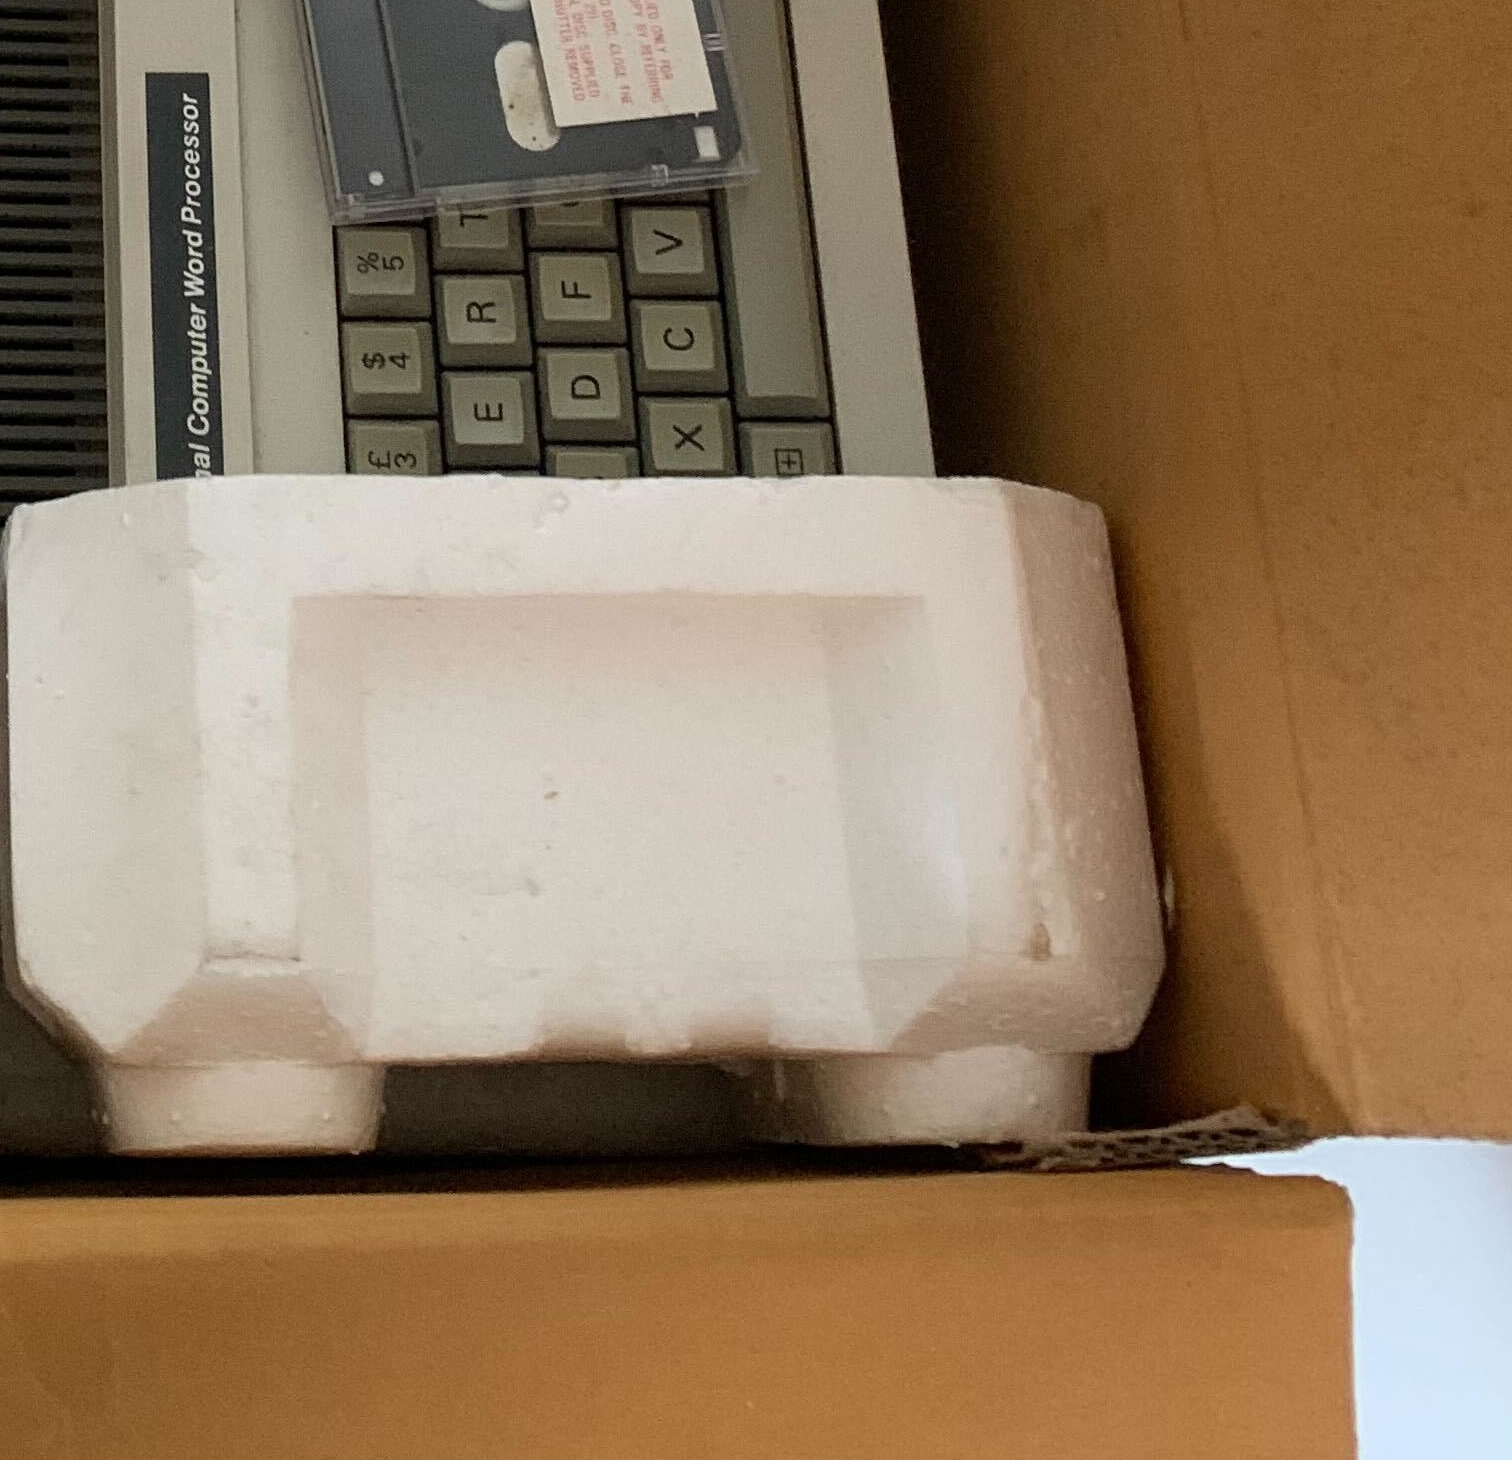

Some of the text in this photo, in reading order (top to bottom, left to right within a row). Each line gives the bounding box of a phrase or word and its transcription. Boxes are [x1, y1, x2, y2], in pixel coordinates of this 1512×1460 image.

[650, 24, 669, 53] ONLY
[578, 44, 600, 98] SUPPLIED
[608, 42, 627, 78] CLOSE
[658, 58, 675, 80] FOR
[563, 47, 586, 101] REMOVED
[617, 85, 633, 105] THE
[181, 93, 202, 224] Processor
[653, 229, 683, 256] V
[183, 229, 205, 298] Word
[382, 255, 405, 271] 5
[561, 280, 591, 299] F
[466, 301, 496, 322] R
[663, 327, 695, 351] C
[188, 303, 211, 435] Computer
[389, 352, 410, 370] 4
[571, 375, 601, 399] D
[474, 403, 503, 421] E
[672, 423, 704, 451] X
[394, 451, 417, 468] 3
